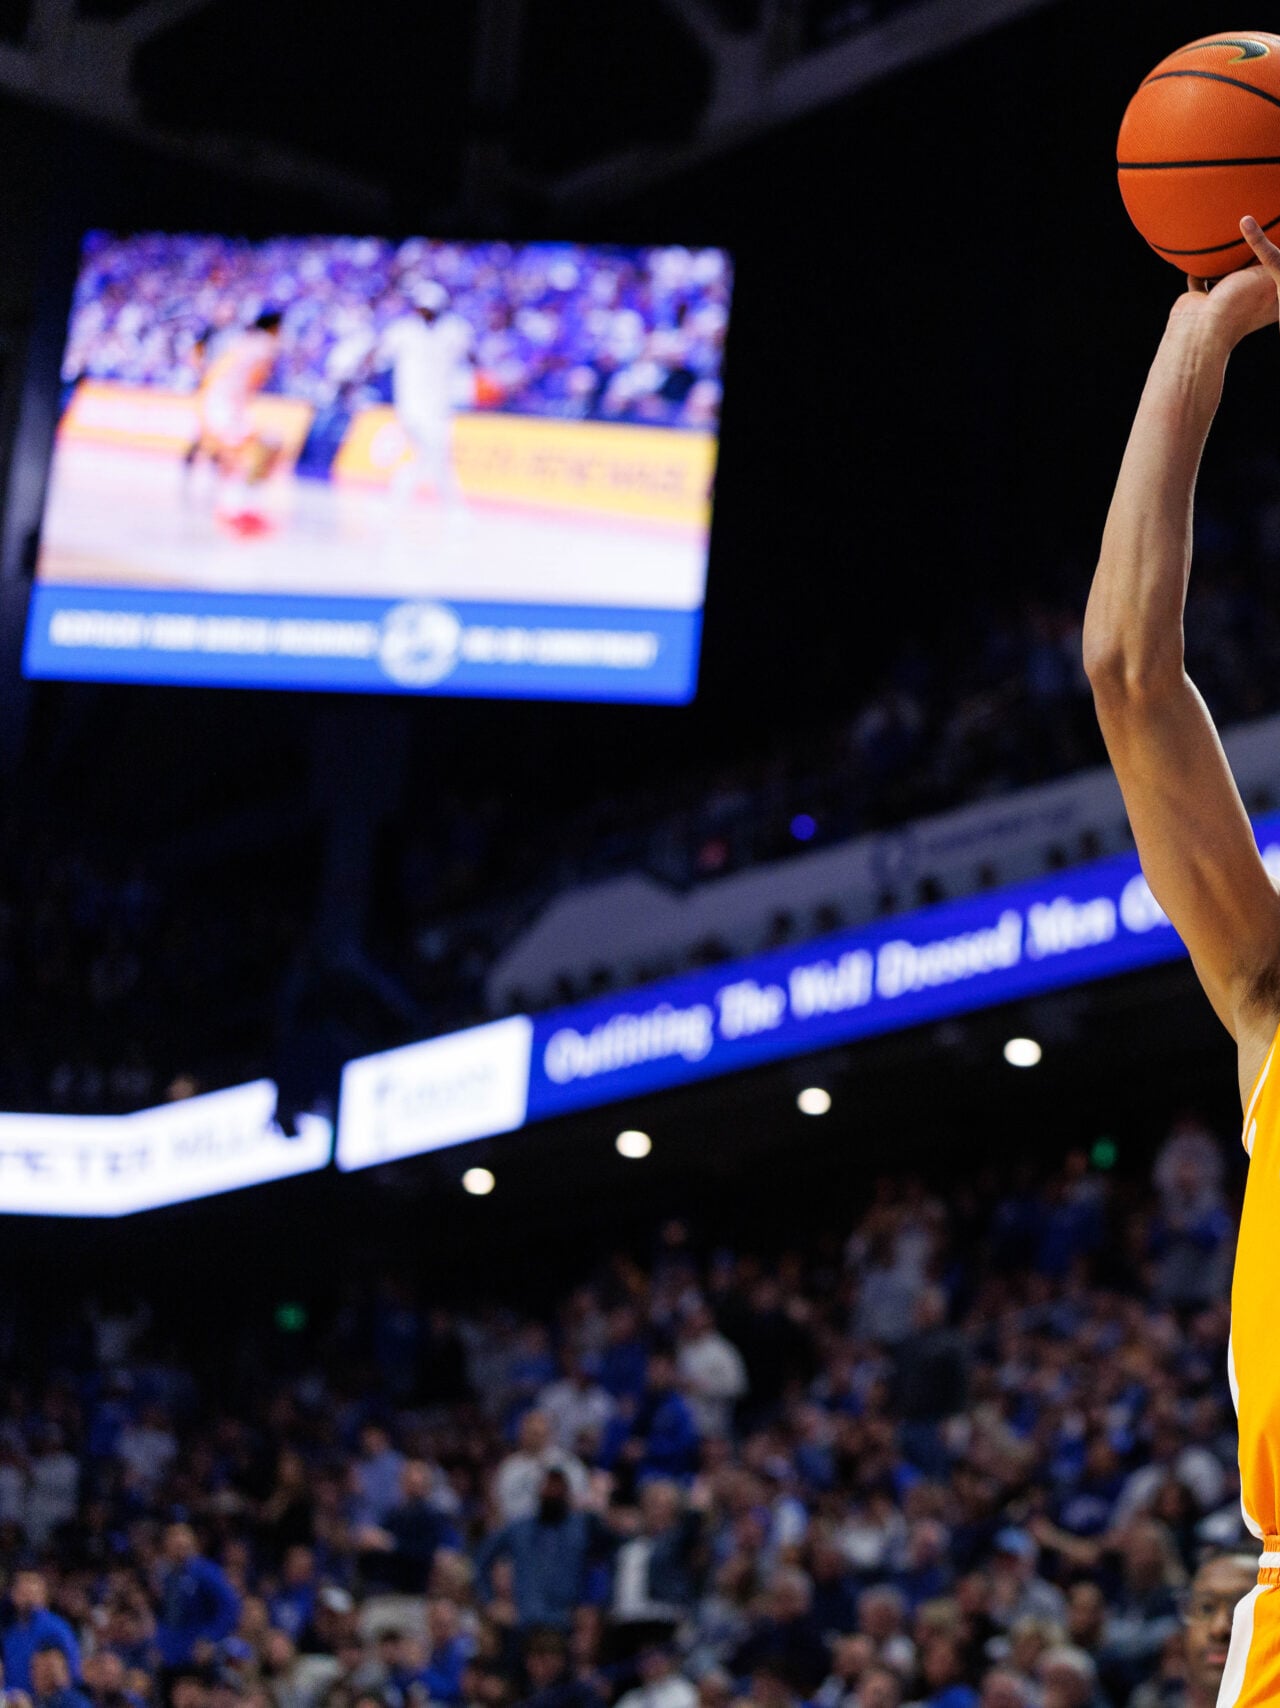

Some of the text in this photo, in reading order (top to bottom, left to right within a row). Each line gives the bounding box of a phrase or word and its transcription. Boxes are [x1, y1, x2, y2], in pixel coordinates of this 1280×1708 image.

[543, 1004, 713, 1084] Outfitting
[714, 979, 787, 1040] The
[788, 949, 874, 1019] Well
[876, 909, 1022, 998] Dressed
[1025, 896, 1116, 960] Men
